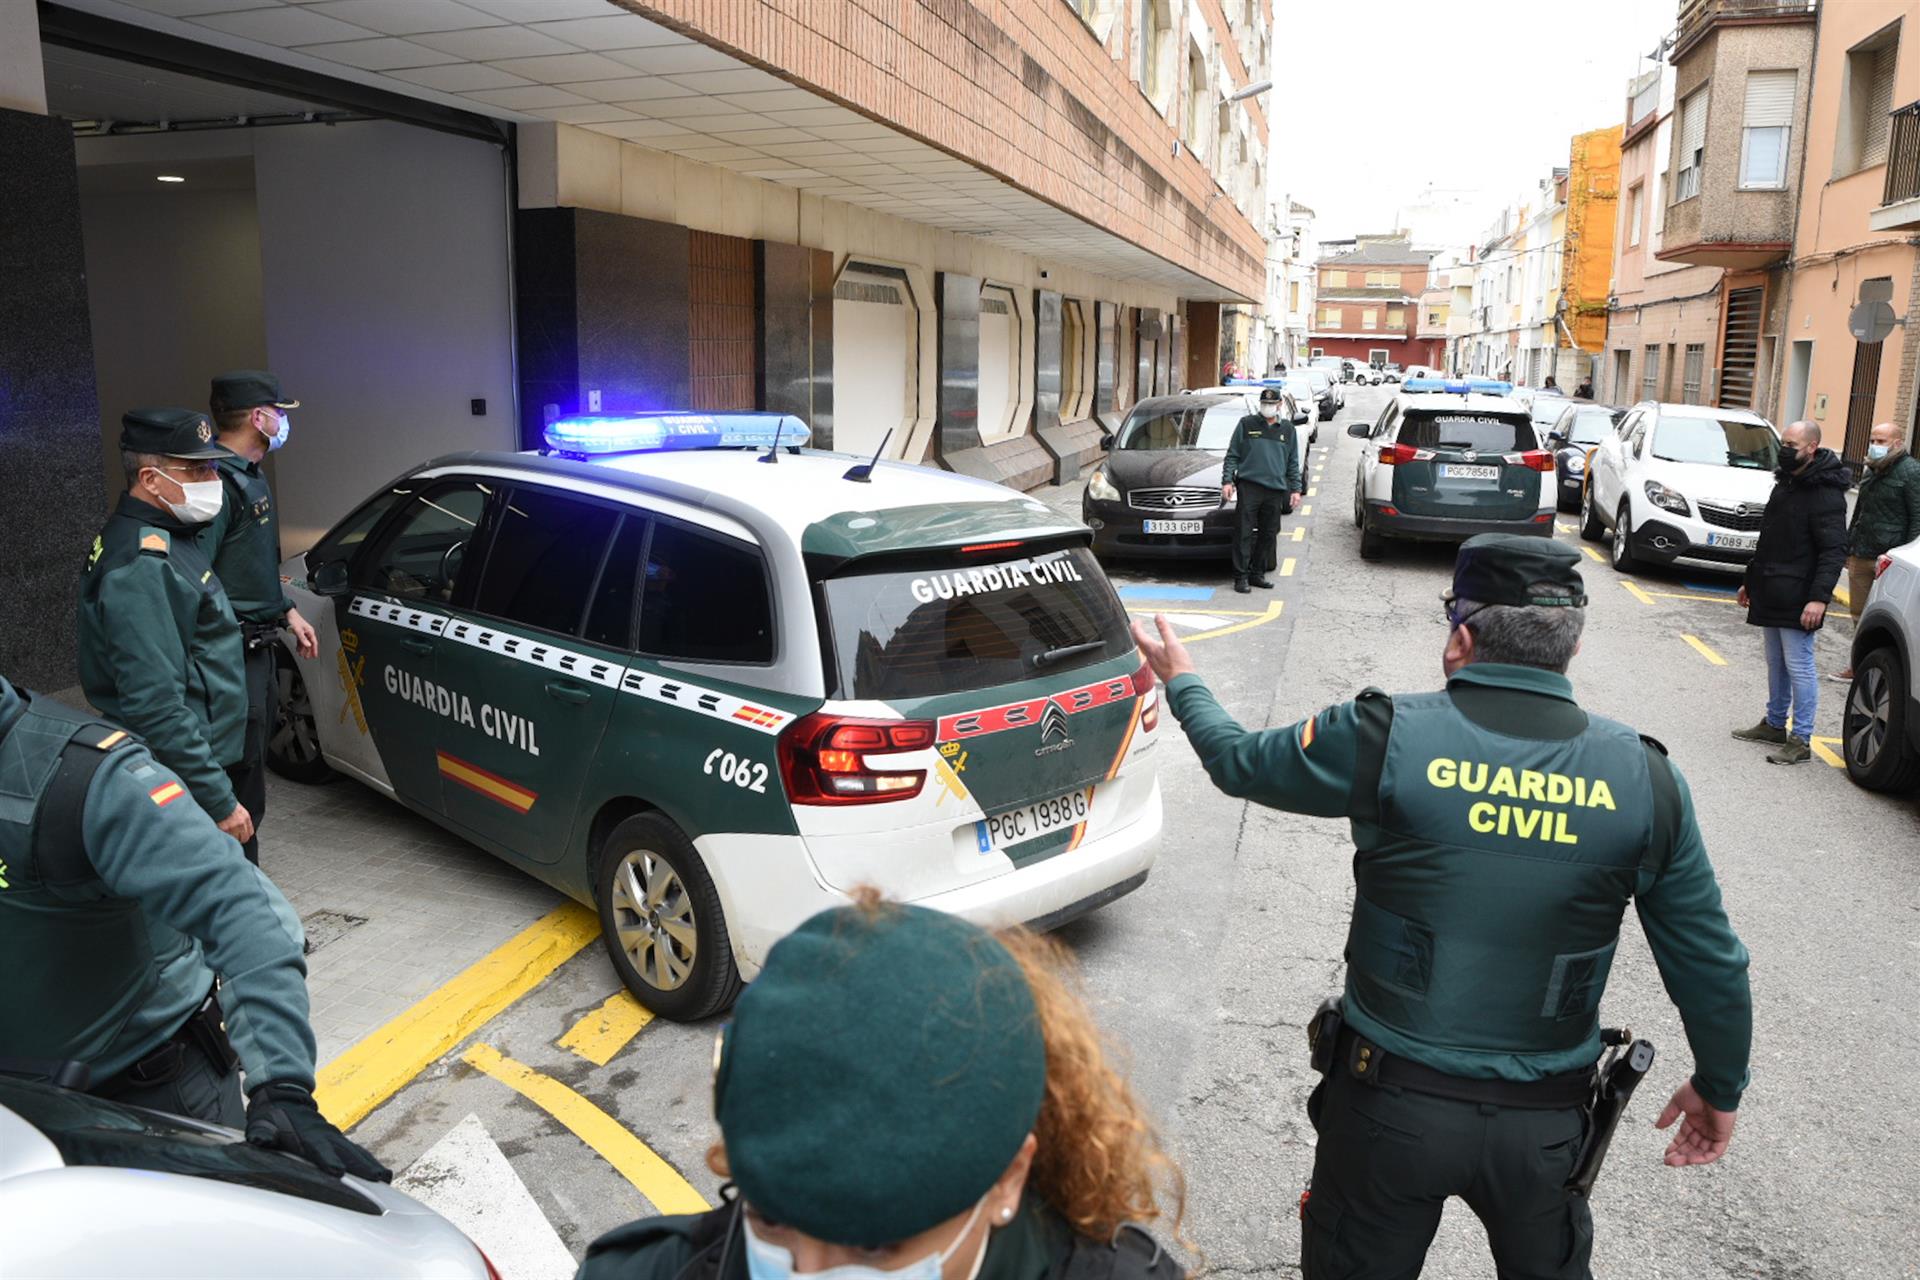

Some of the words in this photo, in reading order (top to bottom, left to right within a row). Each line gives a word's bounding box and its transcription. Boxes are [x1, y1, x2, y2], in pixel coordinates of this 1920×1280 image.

[678, 424, 709, 434] CIVIL
[1434, 415, 1476, 424] GUARDIA
[1477, 417, 1501, 426] CIVIL
[1151, 521, 1177, 532] 3133
[1180, 522, 1201, 532] GPB
[1715, 535, 1742, 547] 7089
[911, 563, 1030, 604] GUARDIA
[1029, 560, 1083, 585] CIVIL
[384, 664, 476, 729] GUARDIA
[480, 703, 540, 756] CIVIL
[719, 752, 769, 794] 062
[1427, 758, 1616, 811] GUARDIA
[990, 811, 1026, 845] PGC
[1030, 797, 1072, 831] 1938
[1073, 792, 1086, 817] G
[1468, 801, 1578, 844] CIVIL
